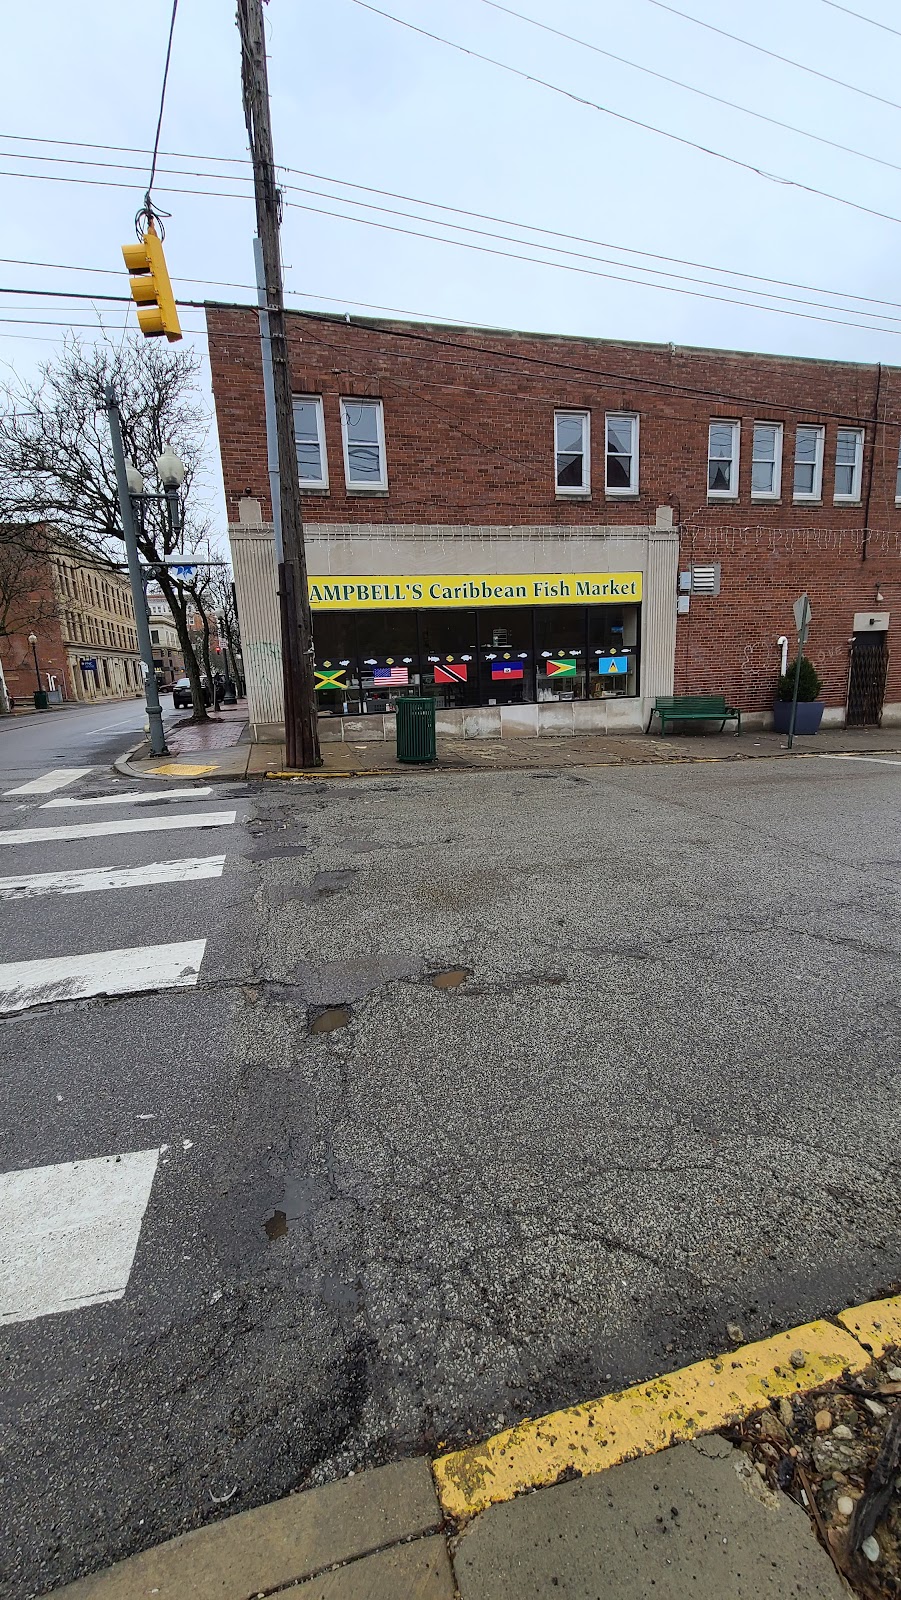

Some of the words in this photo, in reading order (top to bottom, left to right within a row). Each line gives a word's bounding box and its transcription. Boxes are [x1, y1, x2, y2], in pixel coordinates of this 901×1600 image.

[308, 583, 423, 601] AMPBELL'S
[428, 581, 527, 599] Caribbean
[533, 578, 571, 597] Fish
[575, 578, 637, 596] Market
